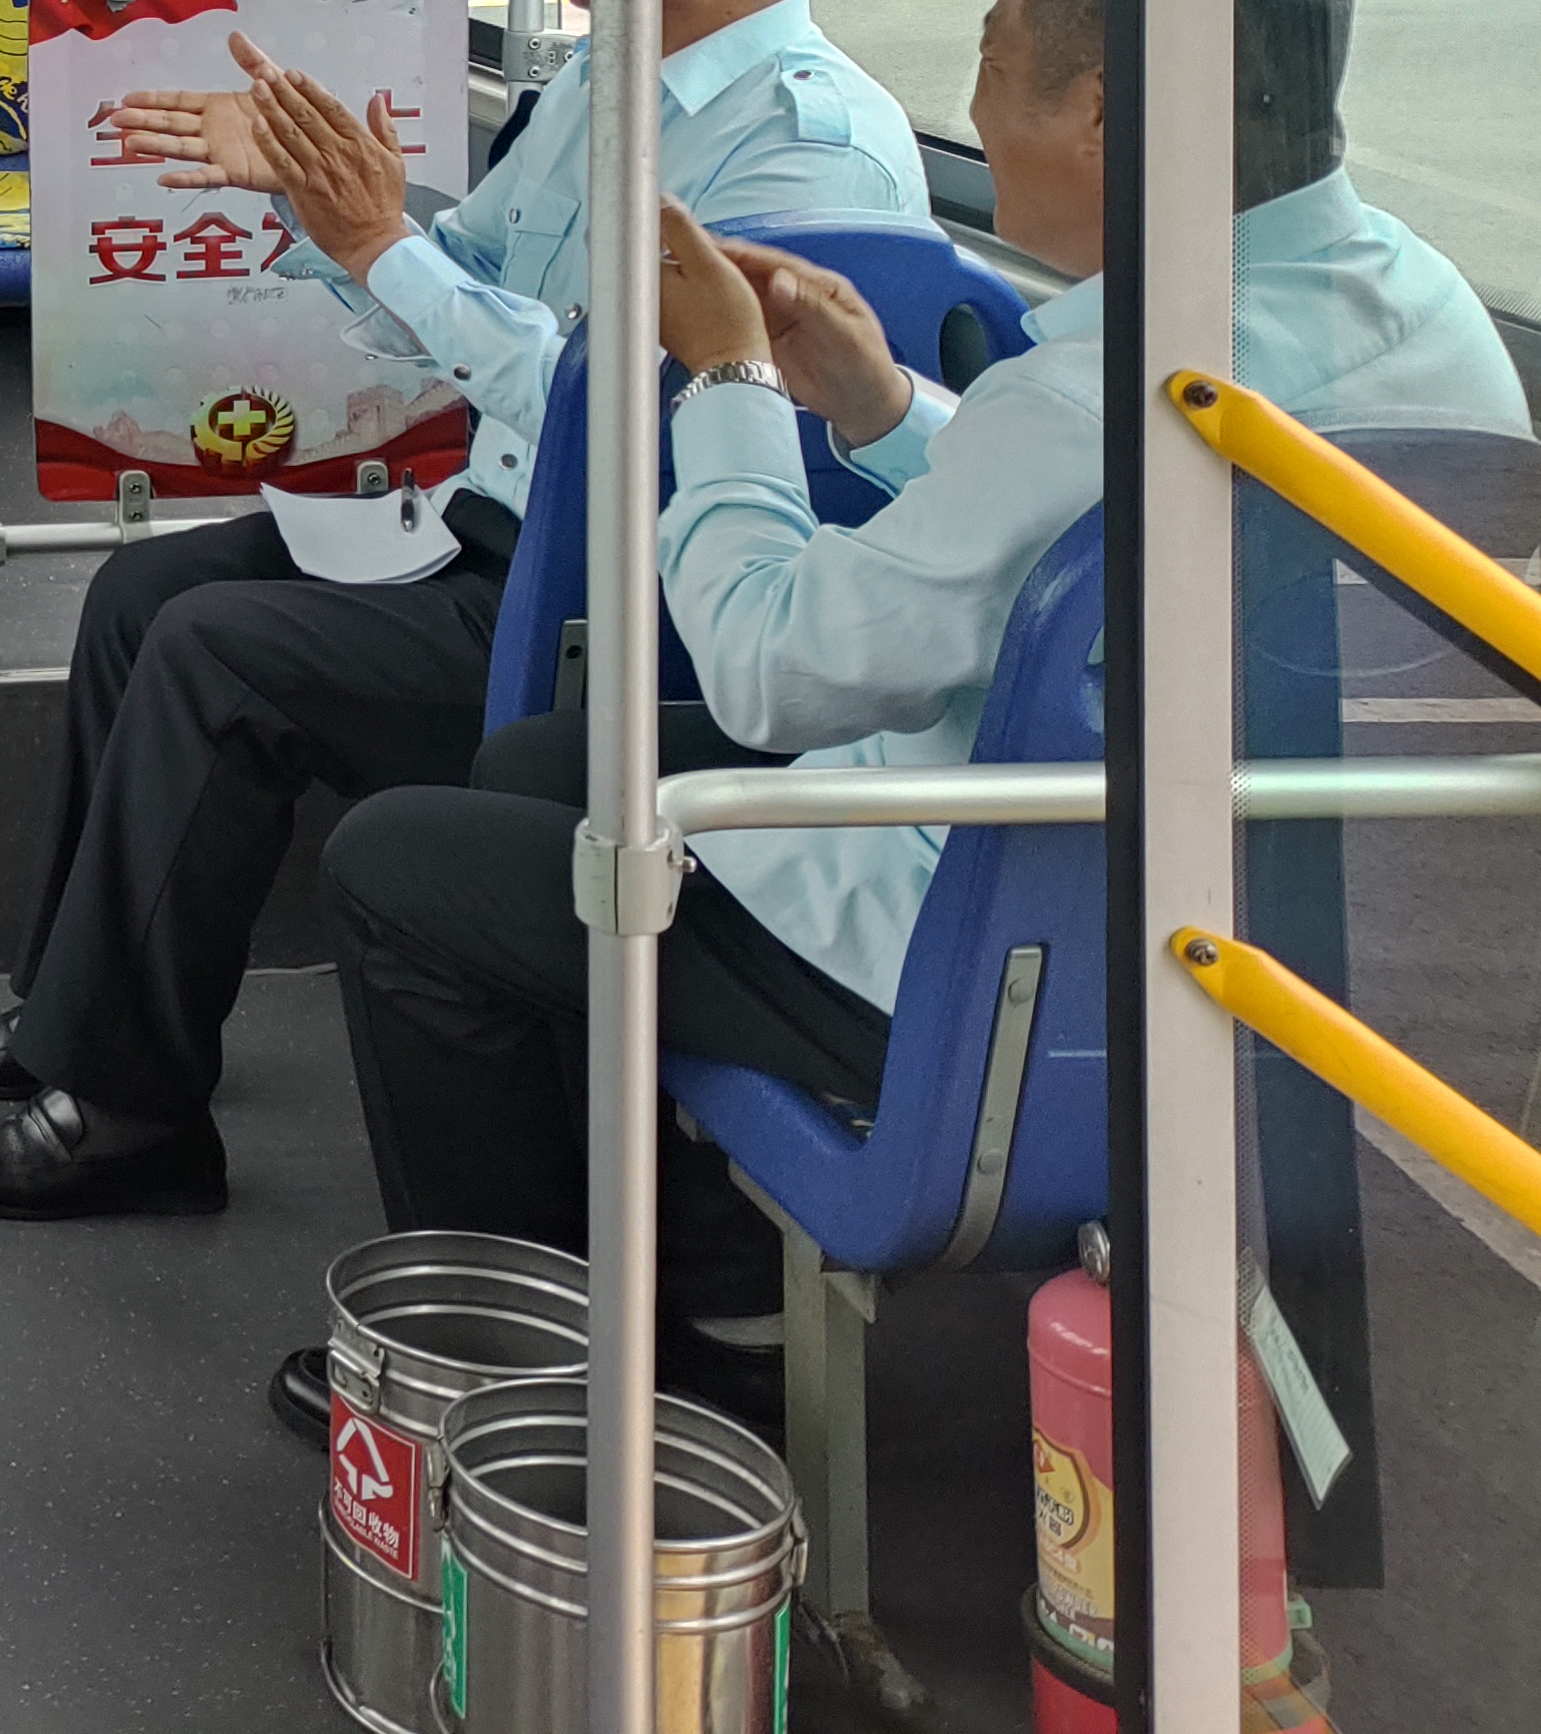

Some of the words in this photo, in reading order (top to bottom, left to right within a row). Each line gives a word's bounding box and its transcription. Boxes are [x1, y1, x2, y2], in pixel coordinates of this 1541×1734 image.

[334, 1477, 400, 1550] 不可回收物
